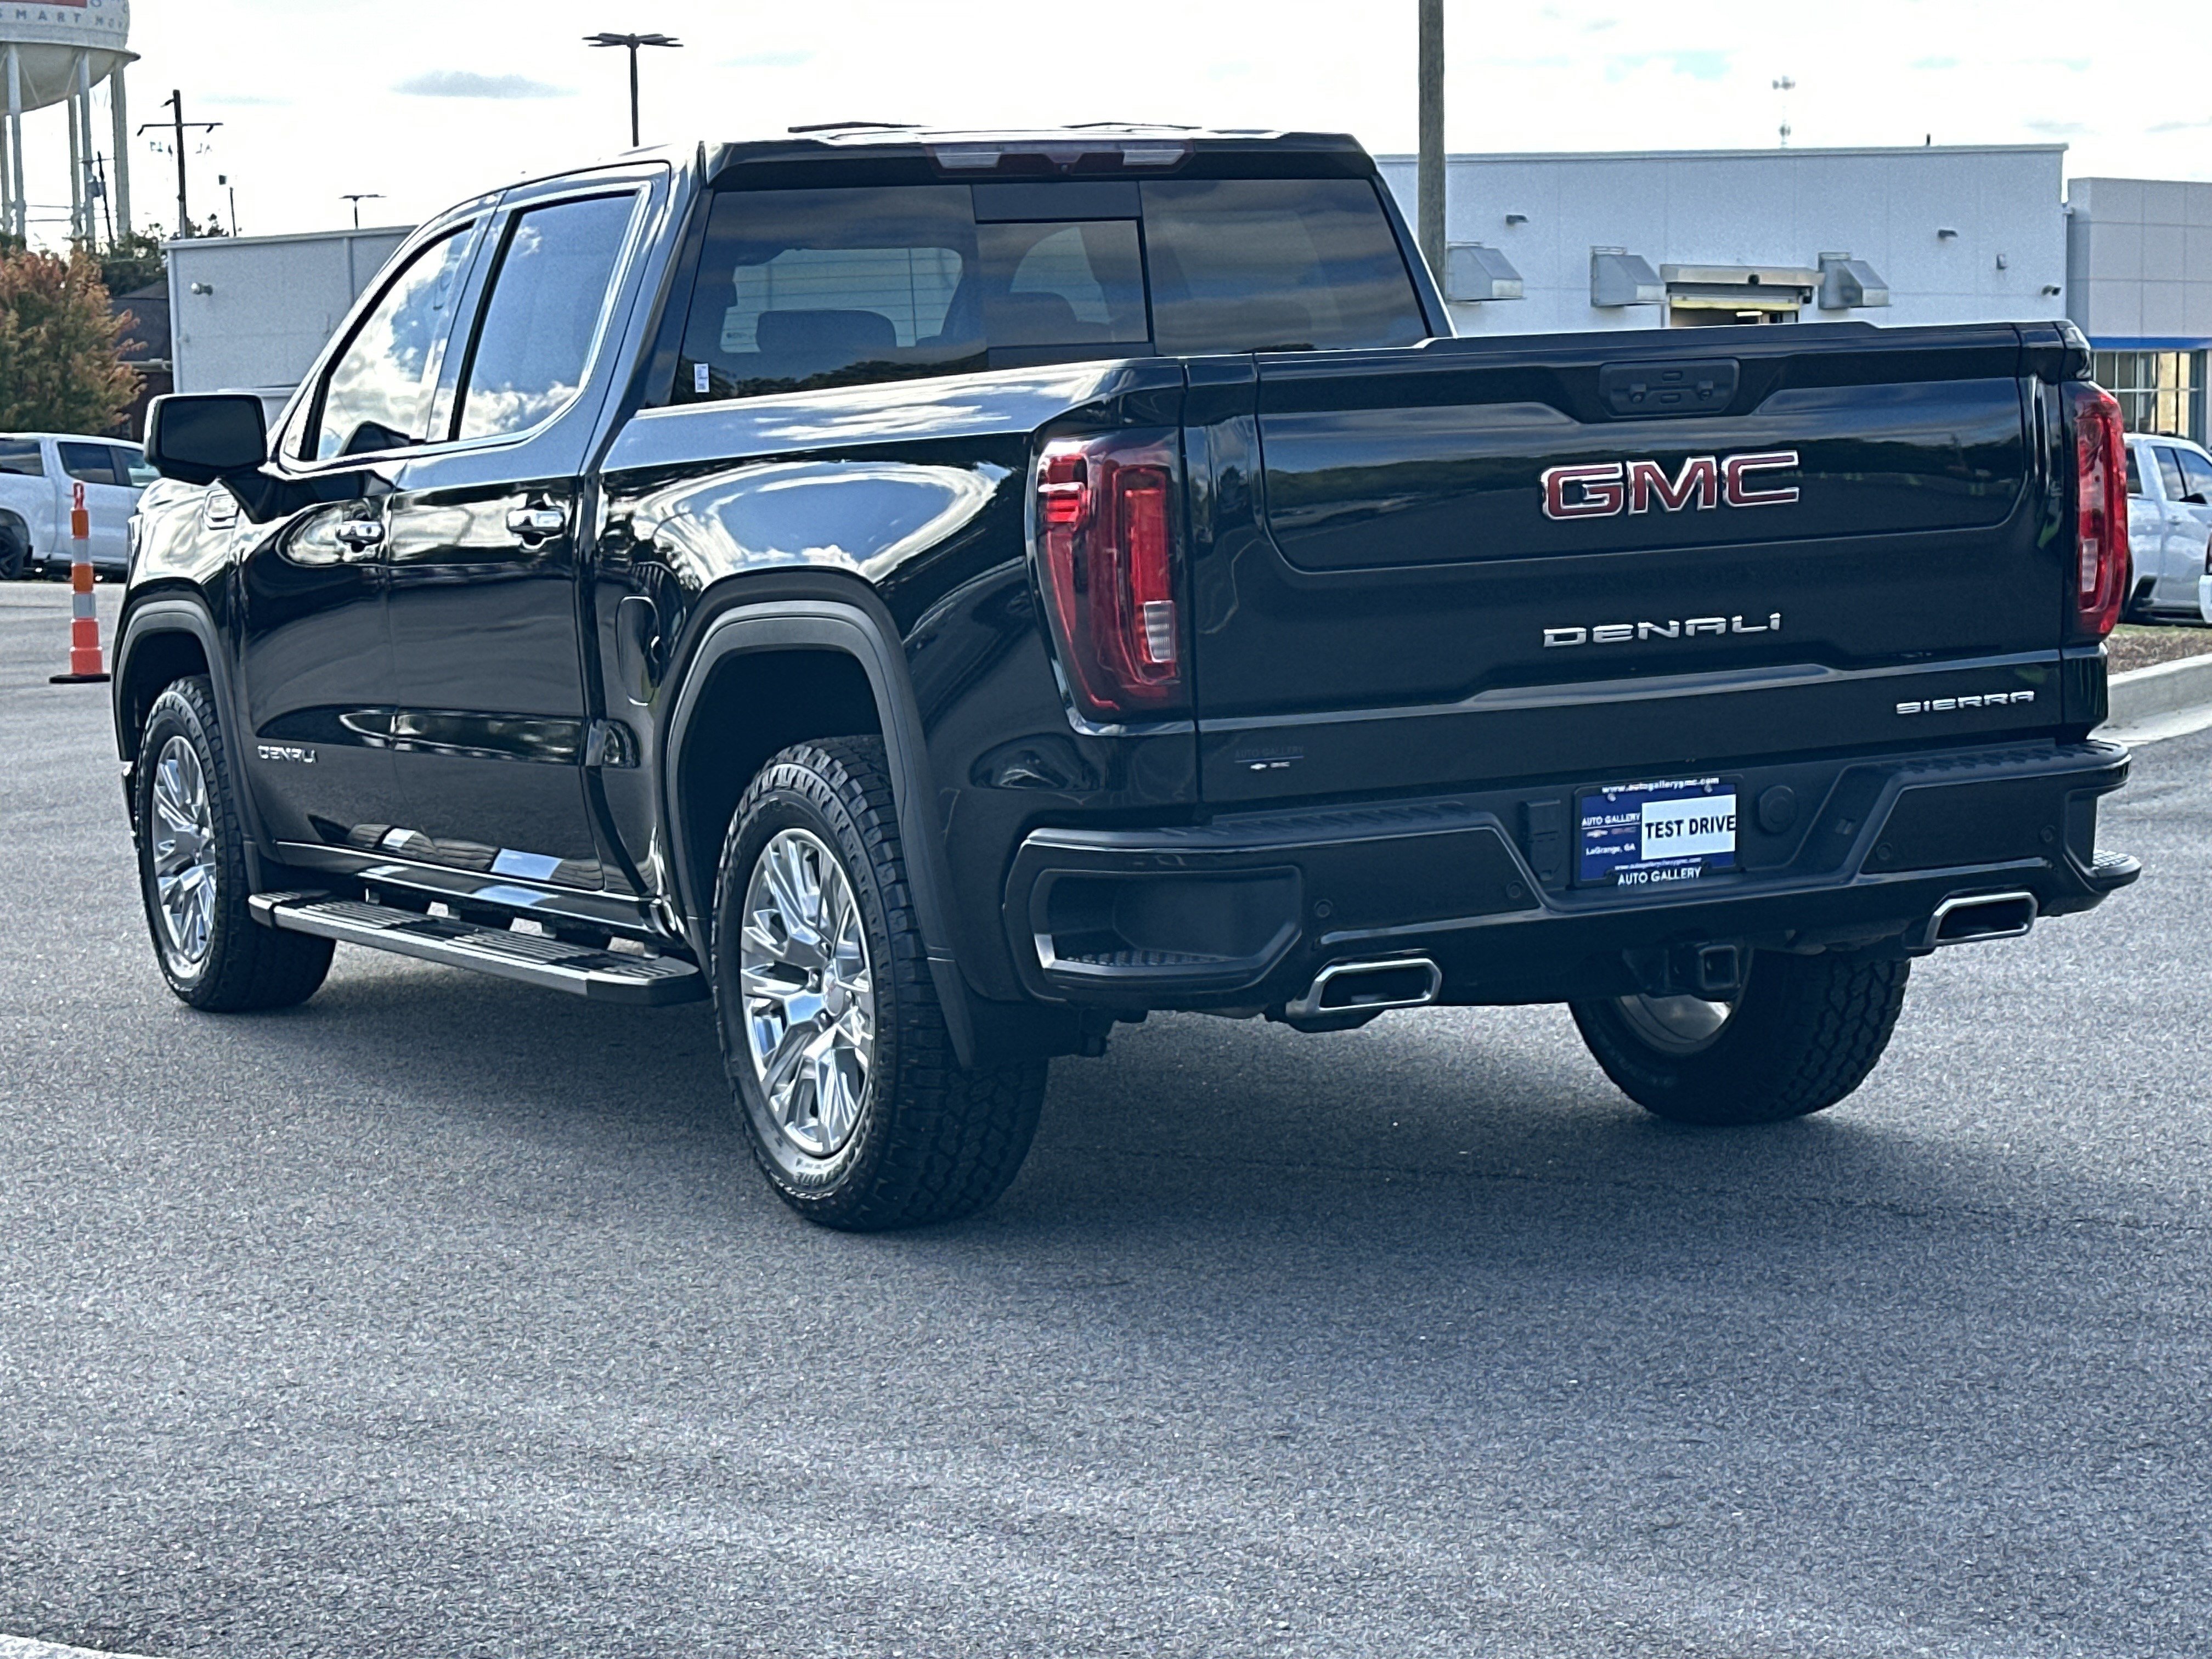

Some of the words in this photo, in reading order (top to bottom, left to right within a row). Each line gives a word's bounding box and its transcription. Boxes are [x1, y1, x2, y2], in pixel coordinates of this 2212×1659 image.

[0, 8, 81, 24] MART
[1541, 450, 1799, 520] GMC
[1543, 612, 1781, 647] DENALI
[1897, 691, 2035, 714] SIERRA
[257, 745, 318, 763] DENALI
[1582, 816, 1602, 827] AUTO
[1605, 812, 1641, 824] GALLERY
[1645, 820, 1684, 839] TEST
[1689, 815, 1736, 835] DRIVE
[1618, 871, 1648, 885] AUTO
[1651, 866, 1702, 882] GALLERY
